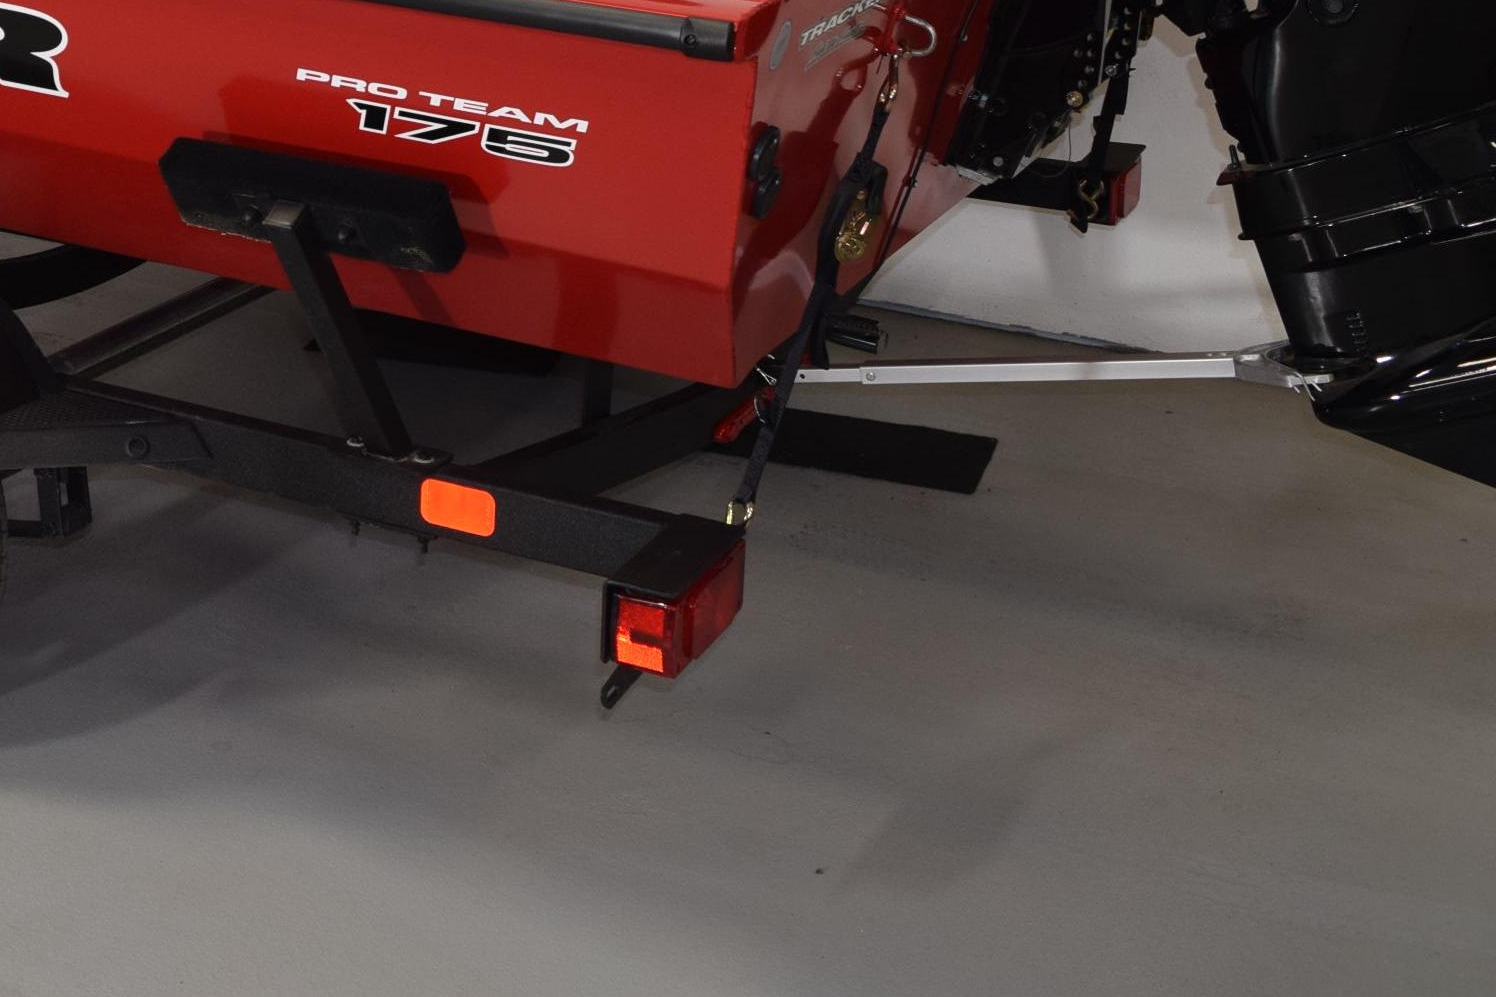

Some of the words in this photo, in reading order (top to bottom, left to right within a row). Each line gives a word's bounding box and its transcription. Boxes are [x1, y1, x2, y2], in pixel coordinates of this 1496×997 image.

[296, 68, 408, 100] PRO
[419, 90, 589, 134] TEAM
[345, 98, 578, 168] 175
